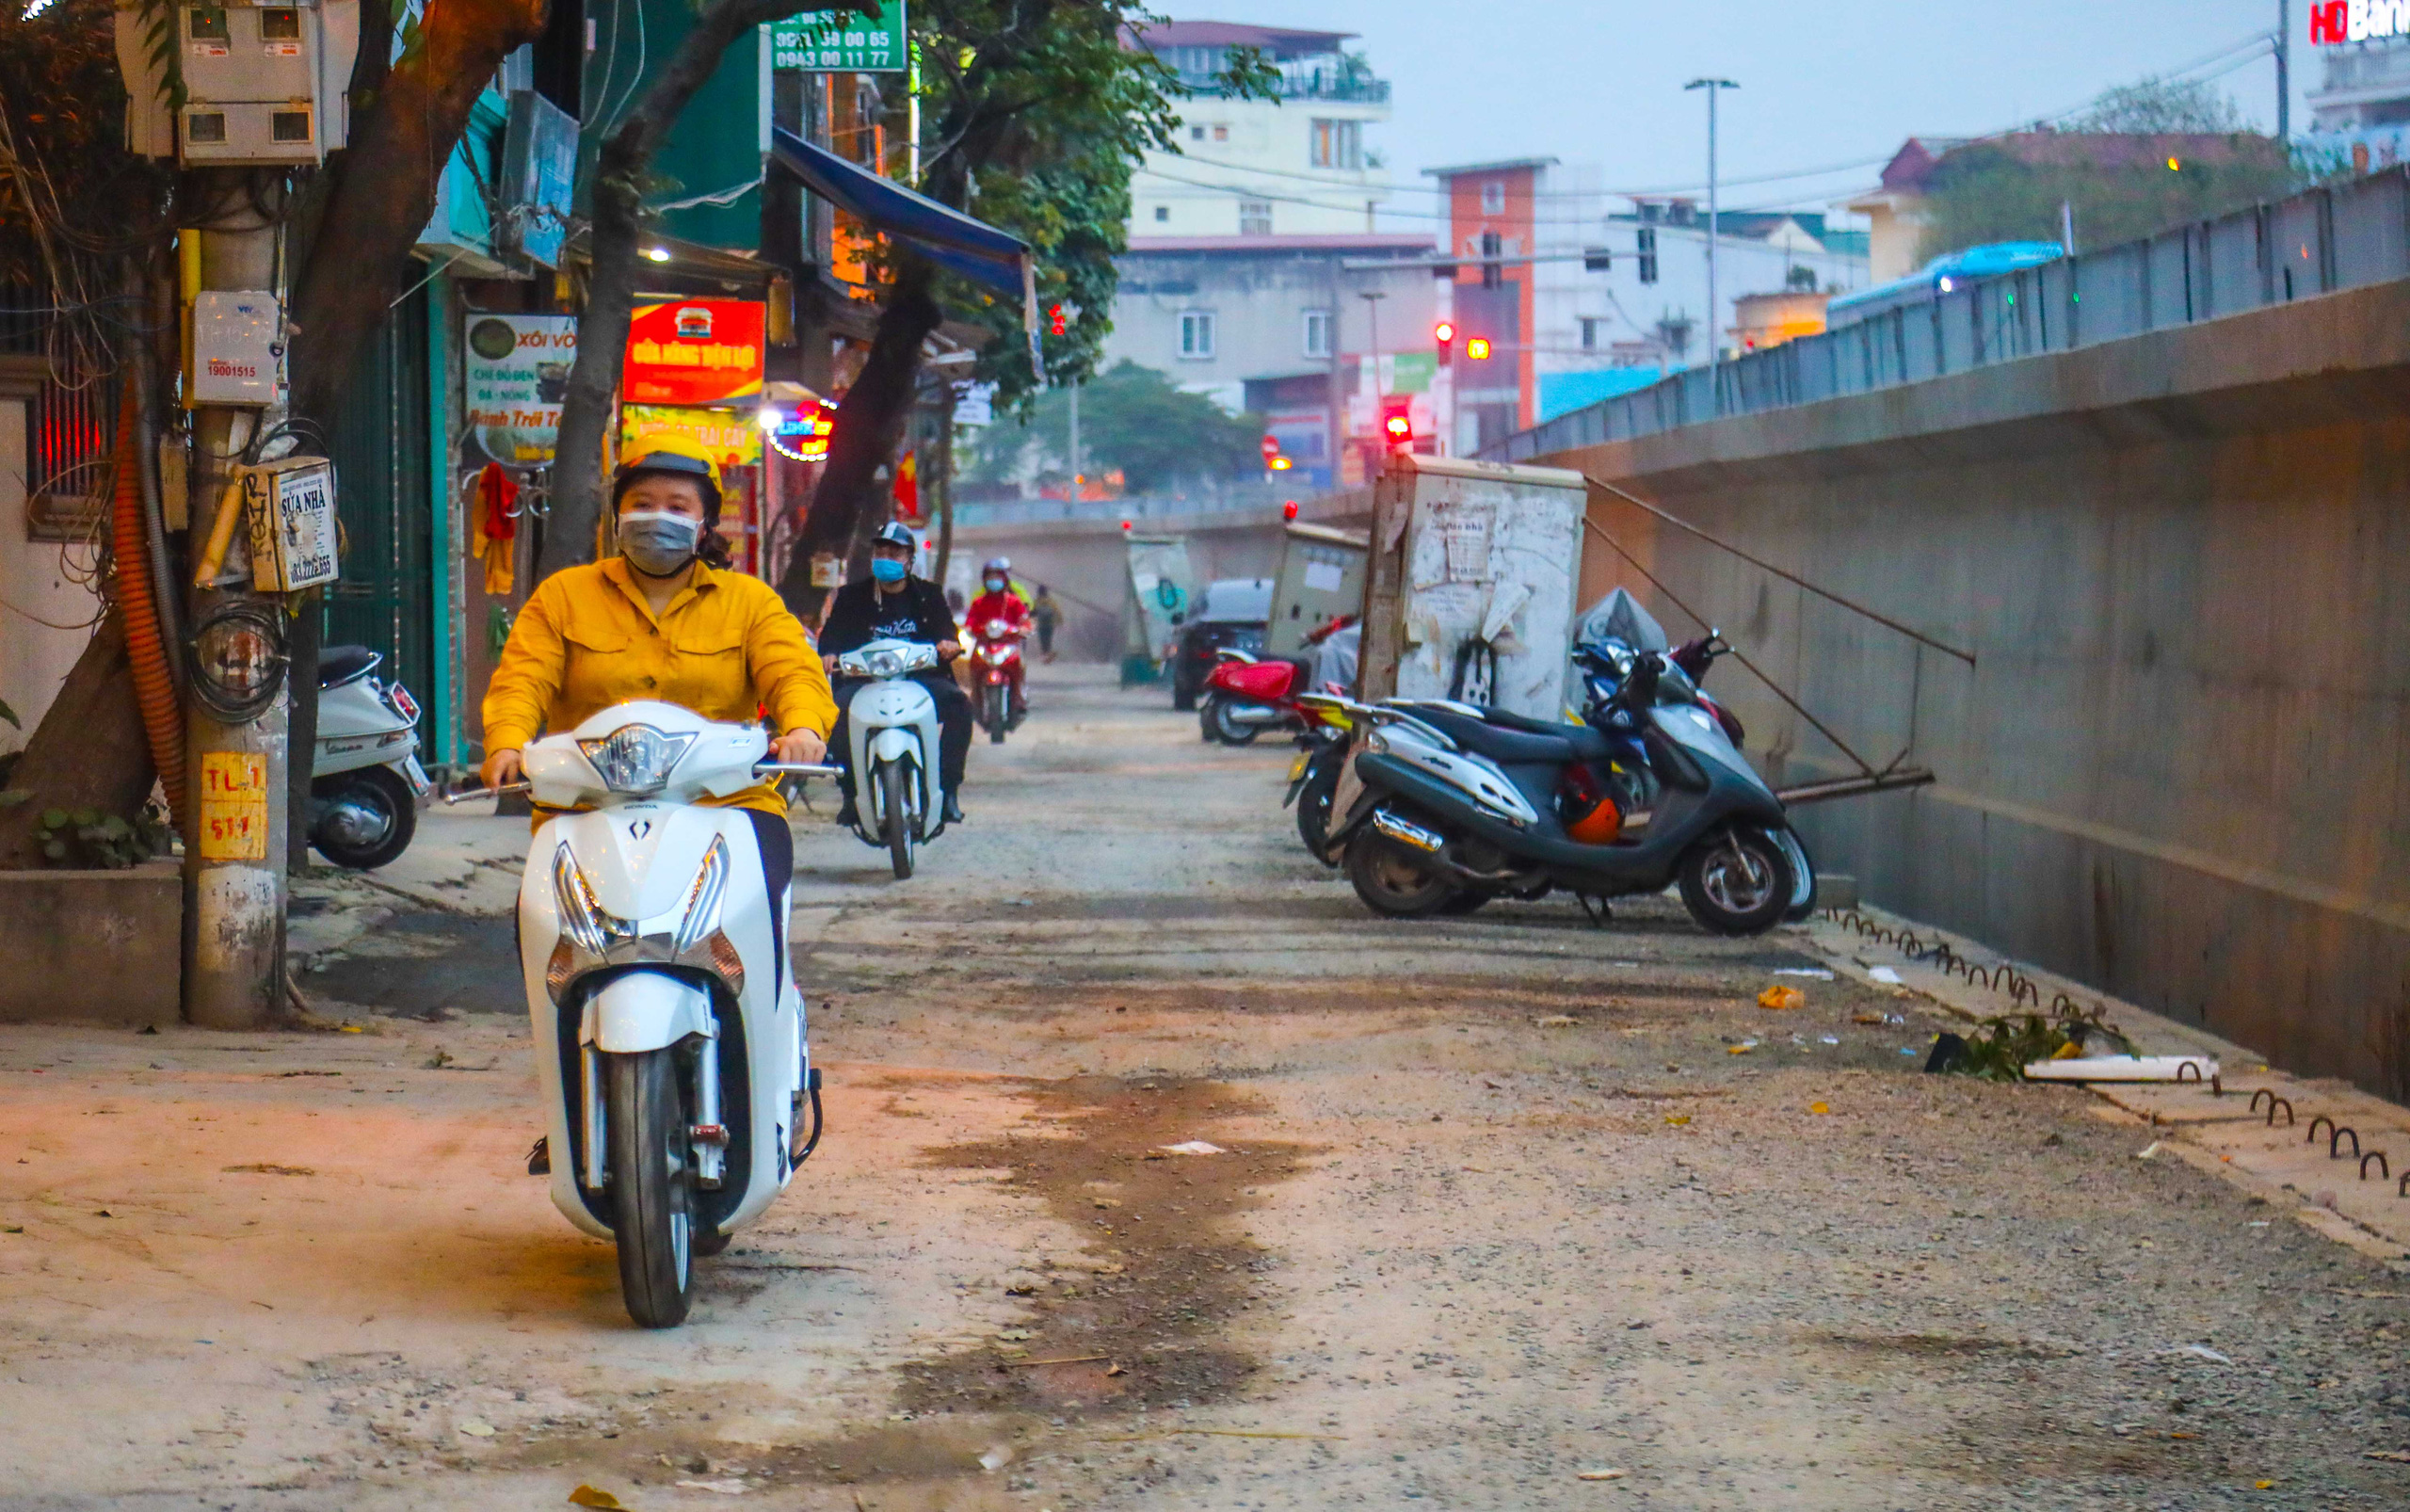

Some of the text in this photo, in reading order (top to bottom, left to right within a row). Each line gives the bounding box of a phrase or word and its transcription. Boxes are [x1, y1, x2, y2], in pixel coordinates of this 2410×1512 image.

[844, 31, 865, 47] 00
[870, 31, 890, 47] 65
[777, 51, 890, 67] 0943 00 11 77
[208, 365, 256, 378] 19001515
[304, 484, 326, 511] NHÀ
